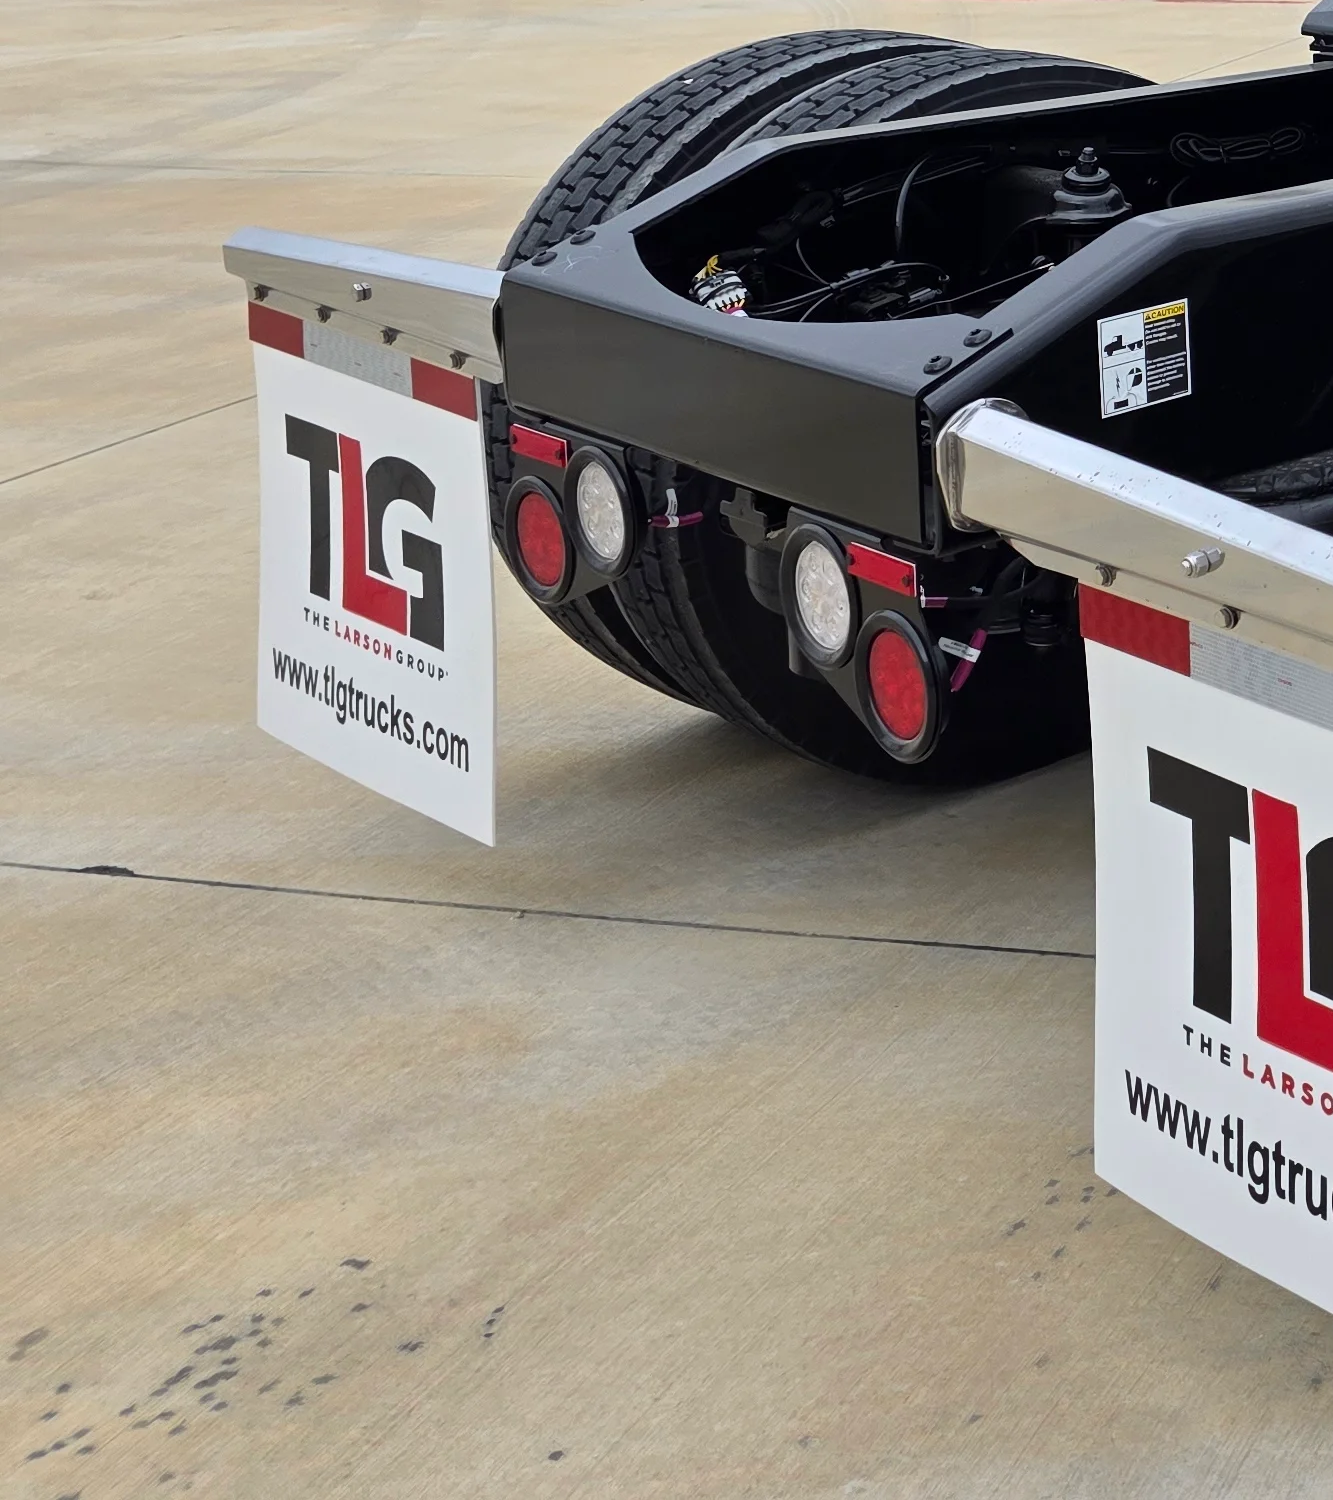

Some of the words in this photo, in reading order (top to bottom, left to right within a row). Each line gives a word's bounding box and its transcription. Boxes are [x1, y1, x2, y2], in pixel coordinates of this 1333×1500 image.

[1151, 304, 1184, 319] CAUTION
[284, 413, 445, 652] TLG
[303, 607, 331, 632] THE
[334, 621, 393, 662] LARSON
[395, 648, 447, 683] GROUP
[272, 646, 471, 773] www.tlgtrucks.com
[1182, 1024, 1233, 1068] THE
